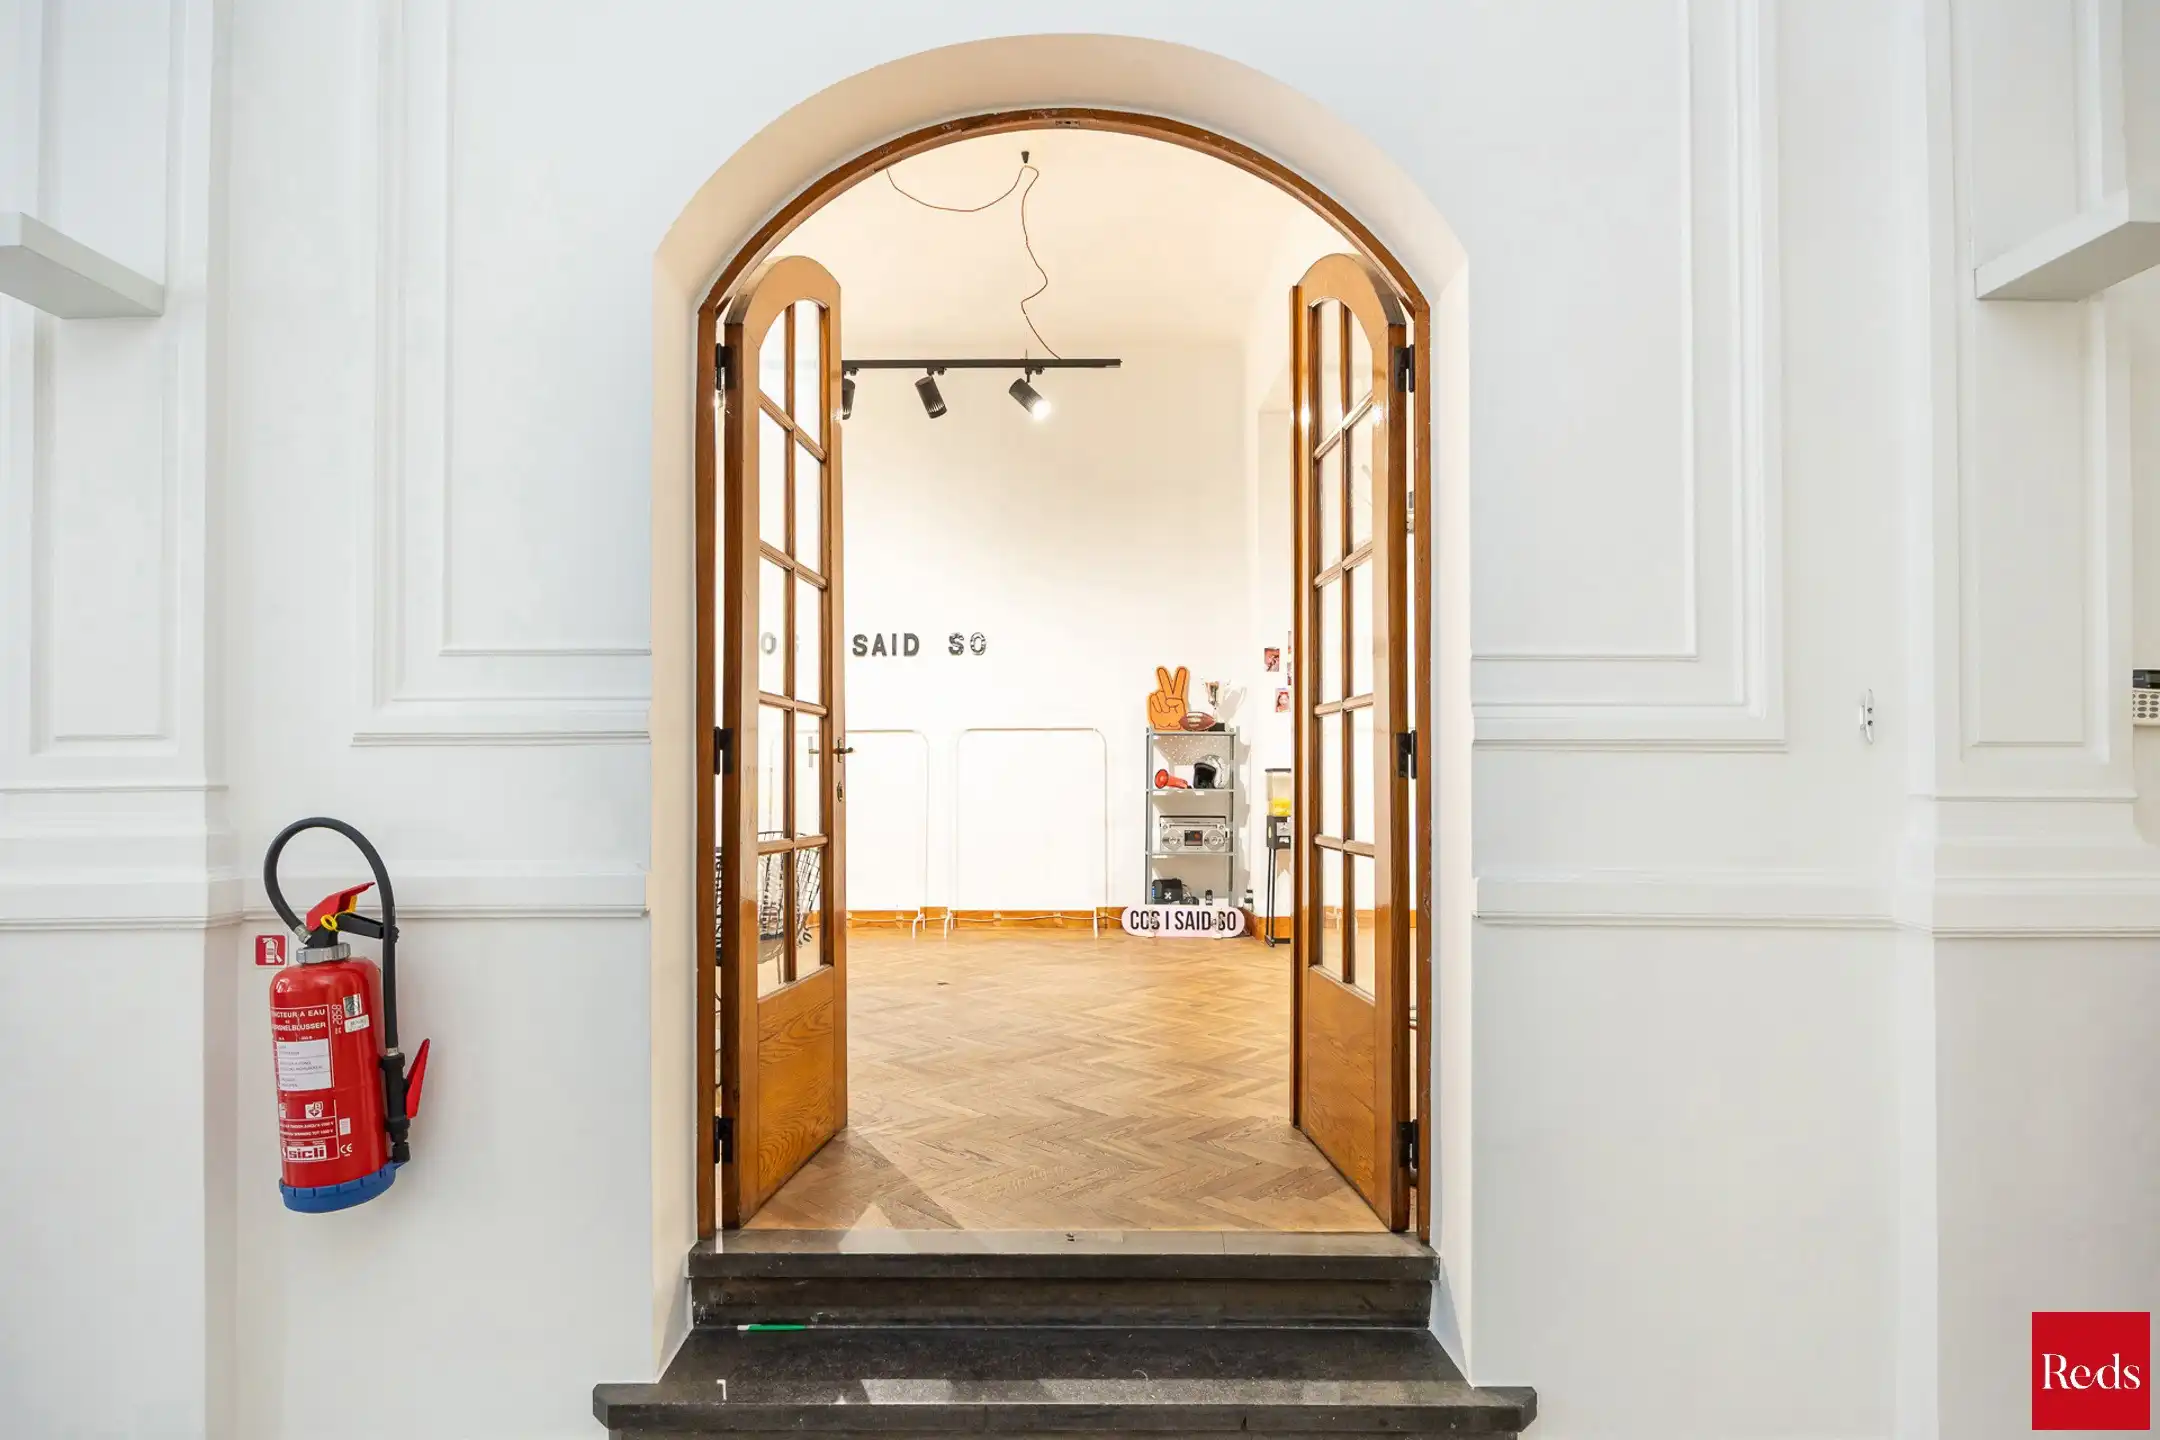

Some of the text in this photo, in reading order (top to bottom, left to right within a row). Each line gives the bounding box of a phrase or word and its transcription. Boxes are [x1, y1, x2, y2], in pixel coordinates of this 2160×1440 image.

[852, 633, 920, 657] SAID
[948, 632, 987, 656] SO
[1165, 910, 1170, 930] I
[1174, 910, 1212, 931] SAID
[1217, 910, 1236, 931] SO
[308, 1009, 325, 1017] EAU
